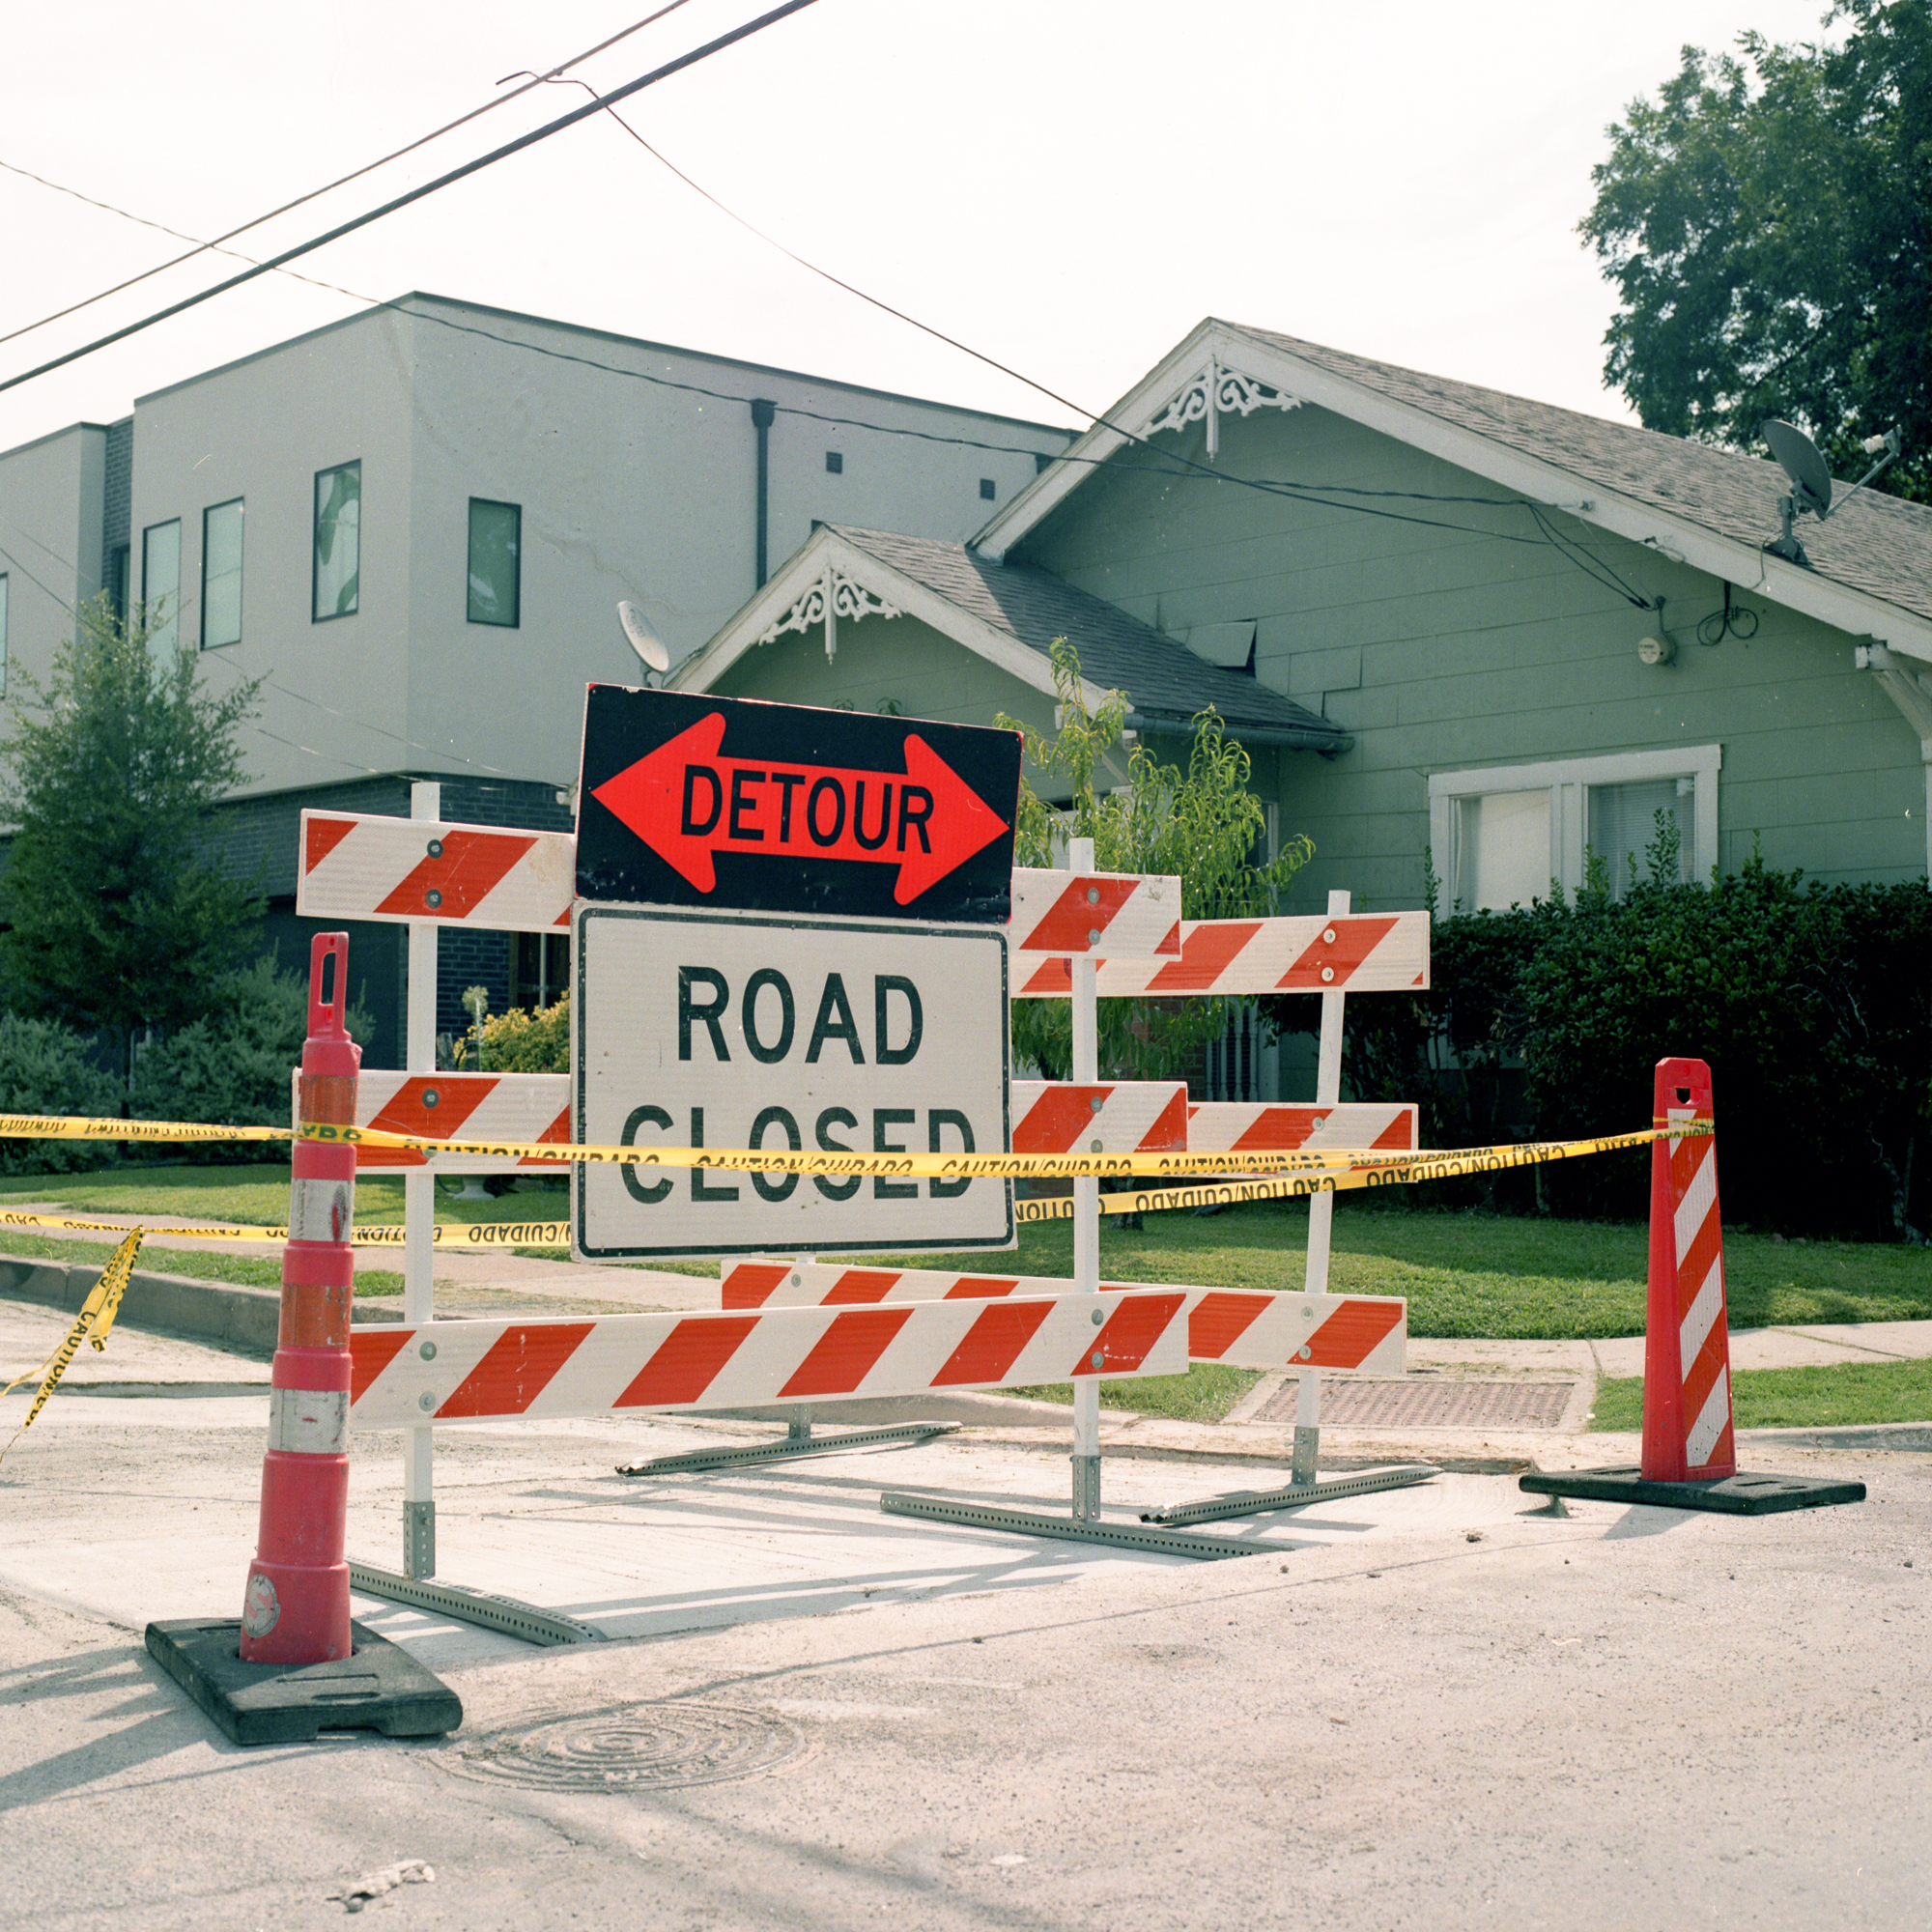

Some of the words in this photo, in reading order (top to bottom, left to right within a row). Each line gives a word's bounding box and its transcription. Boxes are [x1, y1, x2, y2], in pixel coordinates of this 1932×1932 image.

[681, 764, 934, 854] DETOUR
[678, 965, 923, 1065] ROAD
[620, 1105, 976, 1204] CLOSED
